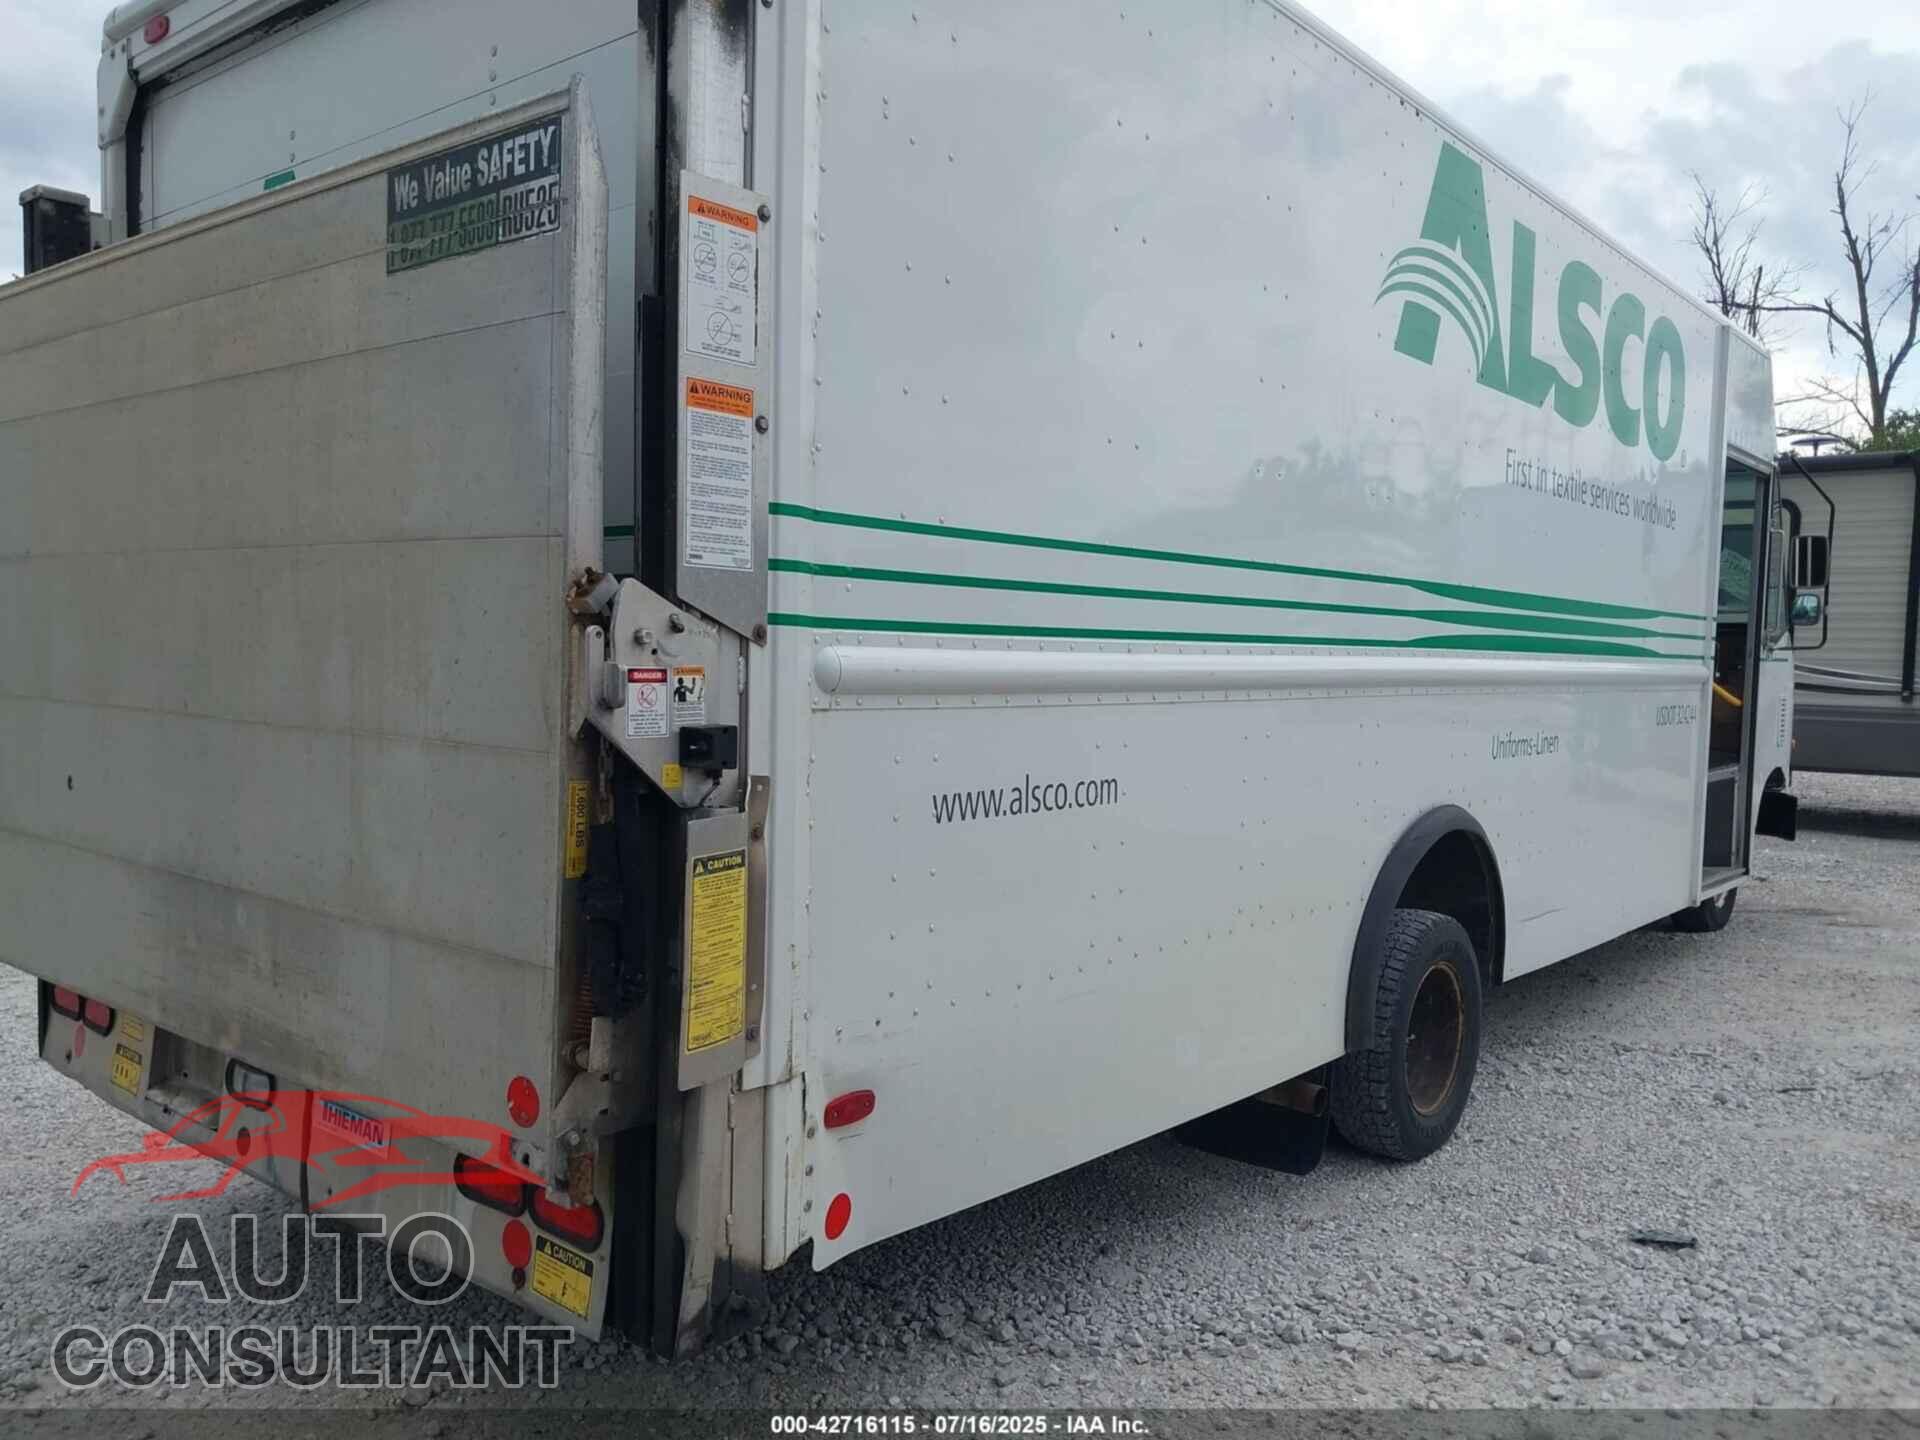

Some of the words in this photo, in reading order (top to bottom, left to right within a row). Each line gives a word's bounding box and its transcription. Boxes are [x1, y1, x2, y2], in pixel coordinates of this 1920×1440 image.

[394, 174, 418, 212] We
[424, 160, 472, 202] Value
[477, 126, 556, 186] SAFETY
[1376, 140, 1686, 462] ALSCO
[700, 384, 751, 403] WARNING
[1505, 448, 1532, 490] First
[1537, 457, 1548, 493] in
[1552, 467, 1587, 505] textile
[1590, 482, 1630, 516] services
[1633, 493, 1676, 530] worldwide
[1491, 731, 1560, 760] Uniforms-Linen
[932, 773, 1118, 824] www.alsco.com
[707, 855, 742, 870] CAUTION
[322, 1101, 385, 1145] THIEMAN
[553, 1246, 586, 1272] CAUTION
